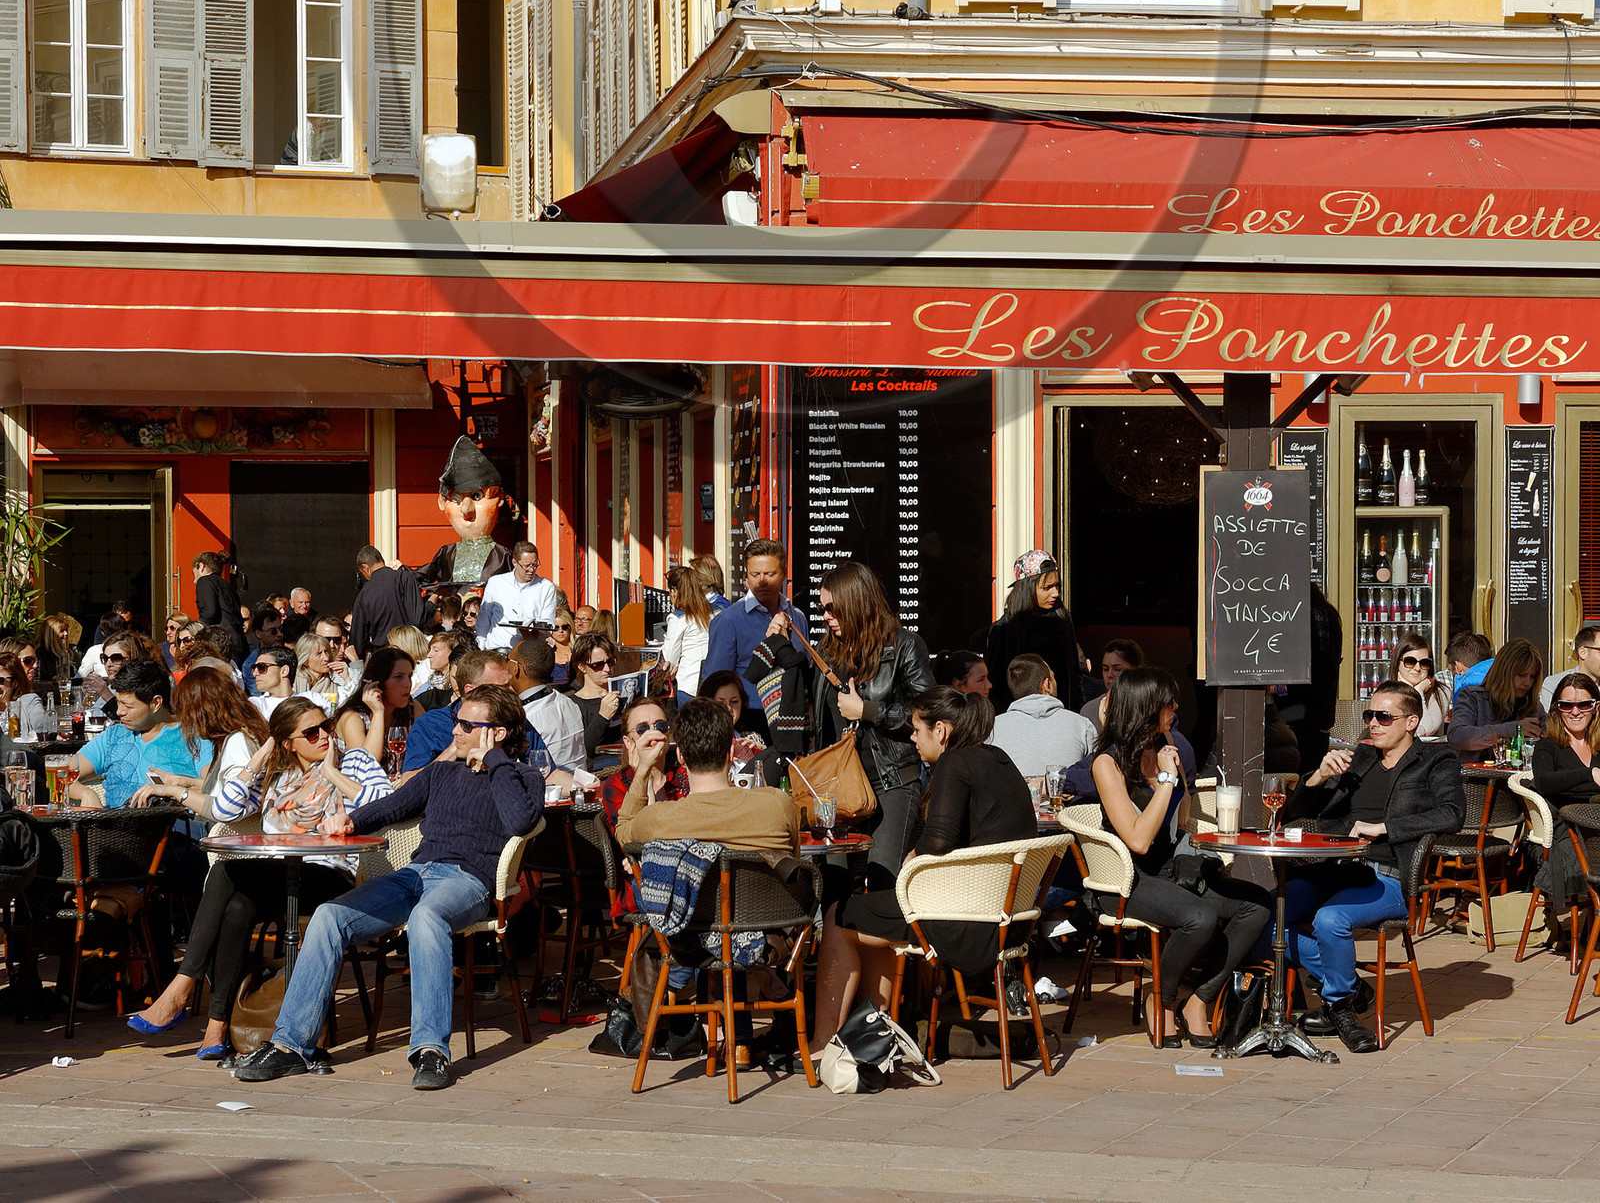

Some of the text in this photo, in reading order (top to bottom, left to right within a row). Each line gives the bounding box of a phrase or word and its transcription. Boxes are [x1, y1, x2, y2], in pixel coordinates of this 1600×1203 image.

[1167, 187, 1305, 235] Les
[912, 293, 1589, 369] Les Ponchettes
[851, 379, 938, 392] Les Cocktails
[1246, 490, 1269, 500] 1664
[1214, 514, 1308, 536] ASSIETTE
[1236, 539, 1266, 556] DE
[1217, 566, 1290, 595] SOCCA
[1222, 601, 1302, 623] MAISON
